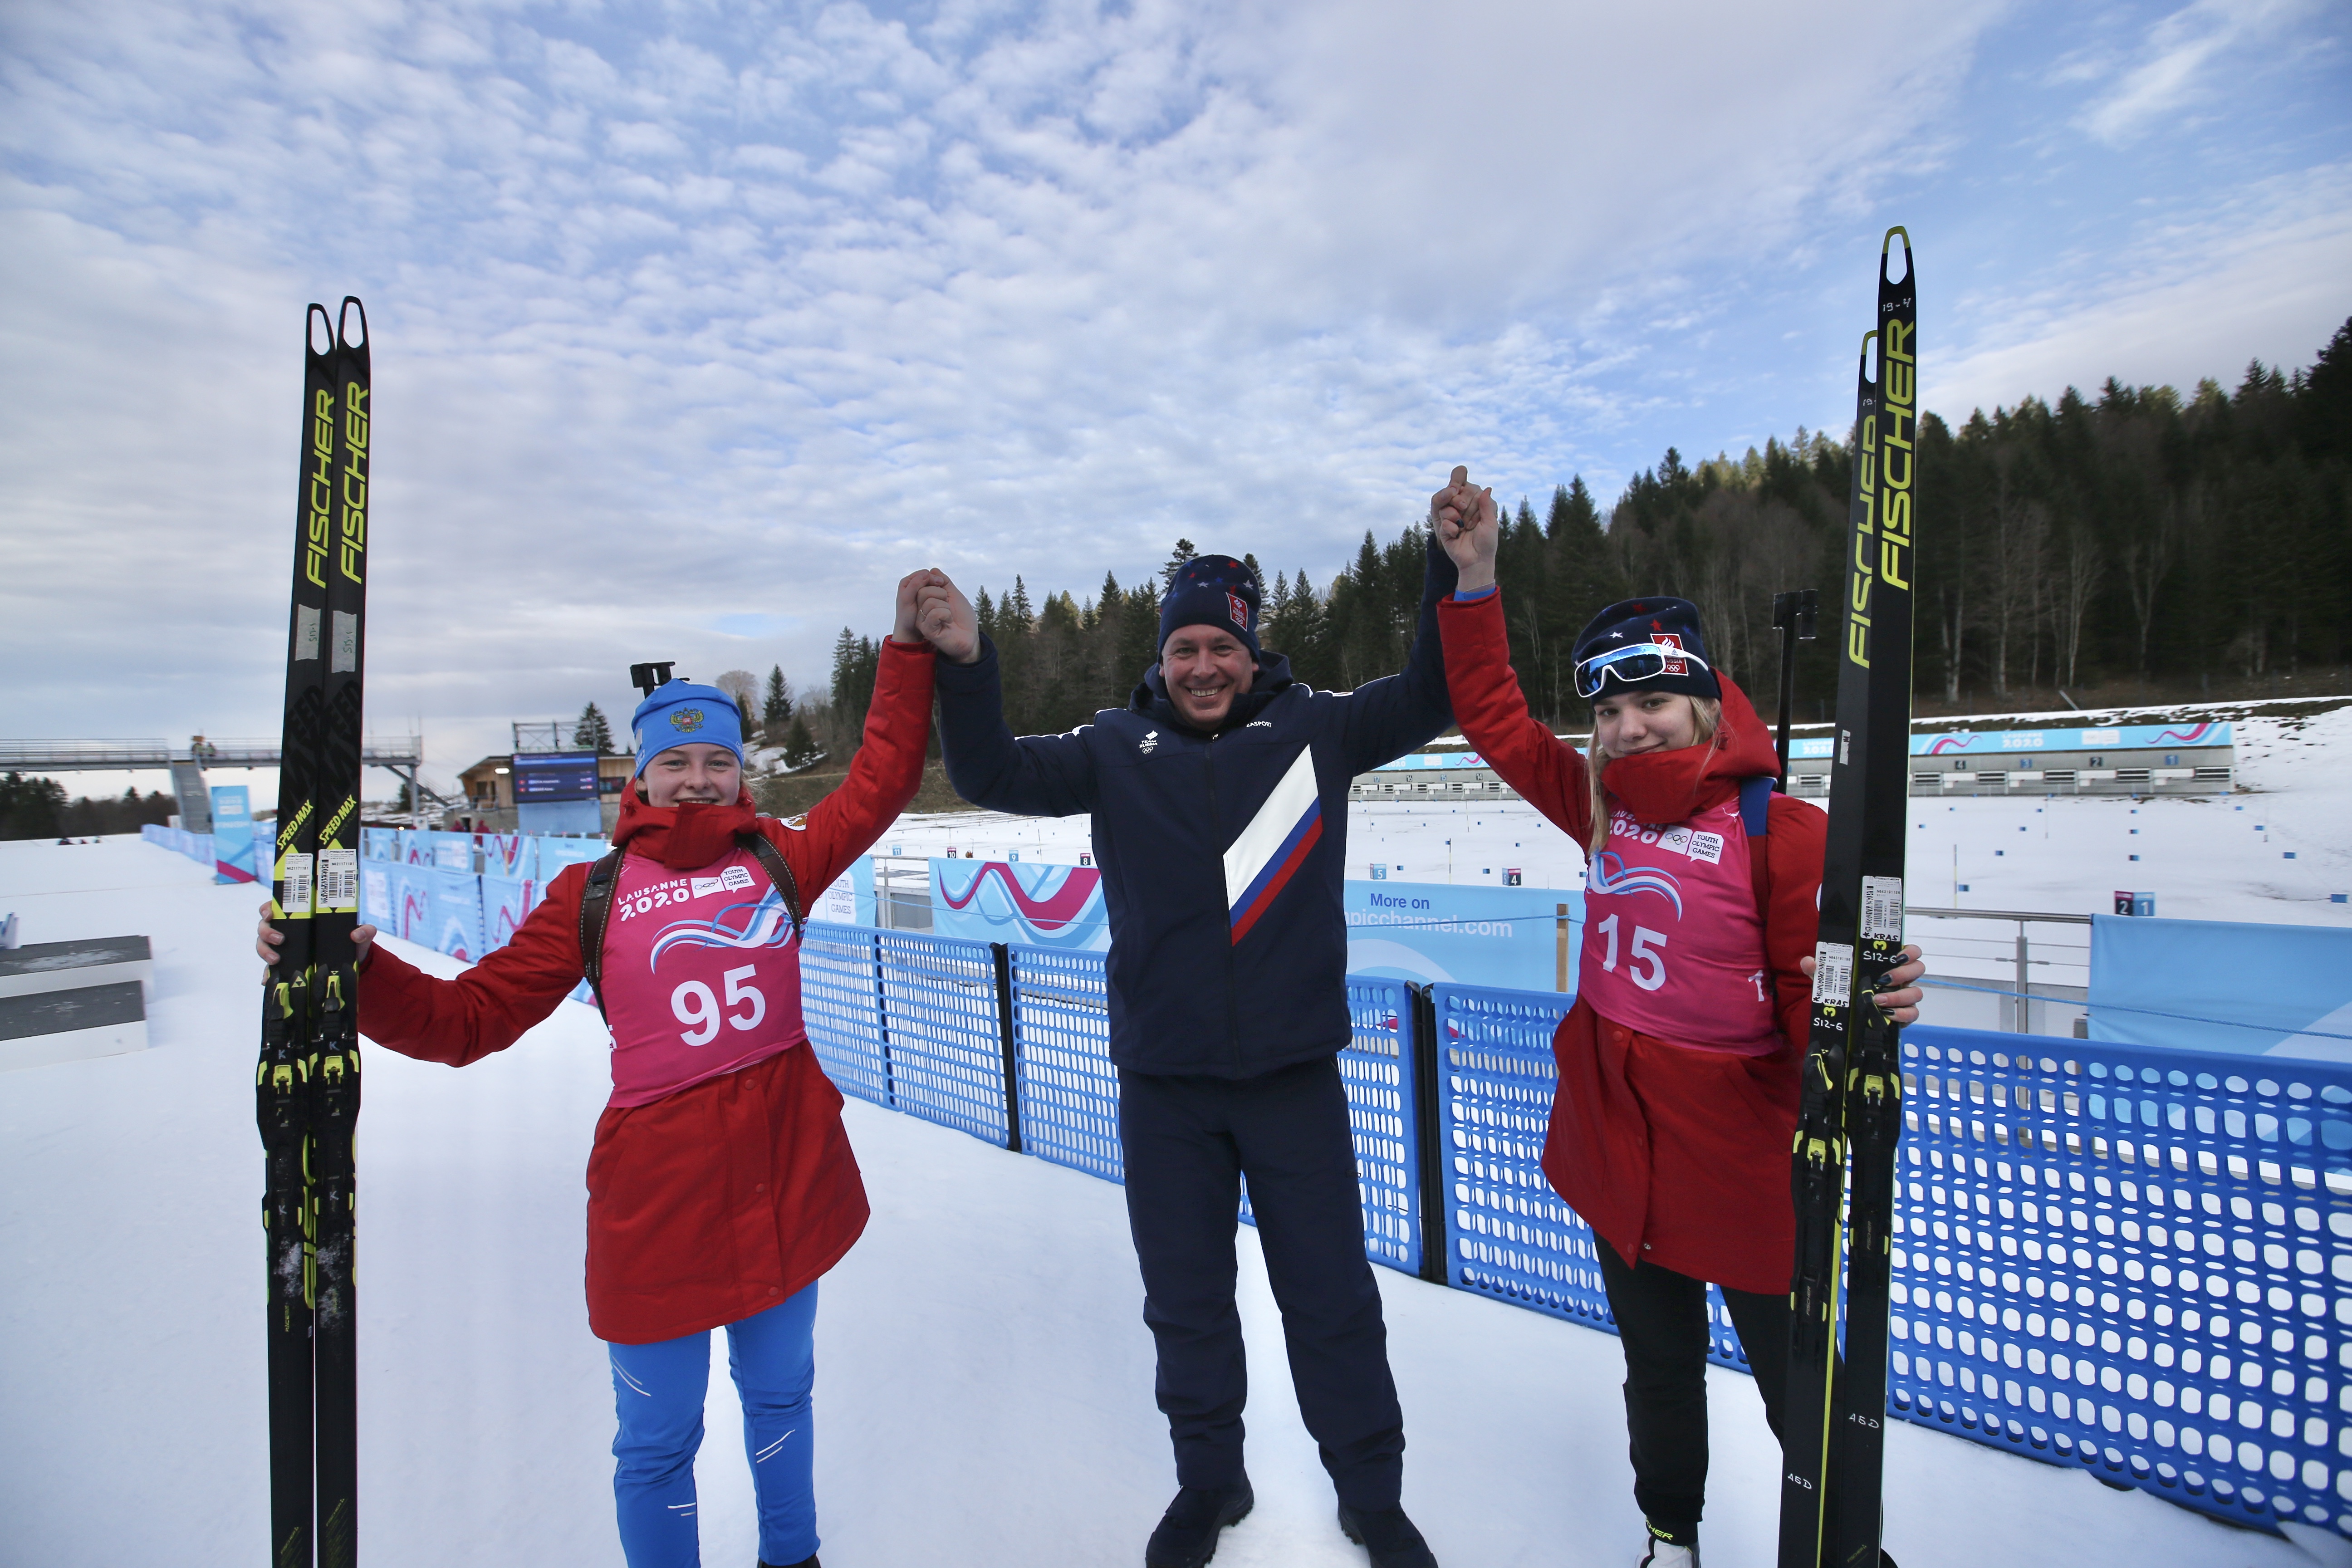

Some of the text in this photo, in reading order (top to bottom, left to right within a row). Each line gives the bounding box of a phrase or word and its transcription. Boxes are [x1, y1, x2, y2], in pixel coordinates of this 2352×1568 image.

[1881, 319, 1914, 591] FISCHER
[306, 389, 335, 588] FISCHER
[341, 382, 368, 584] FISCHER
[2003, 738, 2043, 748] 2020
[277, 820, 298, 850] SPEED
[295, 799, 314, 825] MAX
[319, 794, 357, 845] SPEED MAX
[1697, 834, 1719, 844] YOUTH
[1692, 840, 1720, 852] OLYMPIC
[1693, 848, 1715, 858] GAMES
[1377, 870, 1383, 879] 5
[1511, 874, 1518, 885] 4
[618, 879, 687, 905] LAUSANNE
[828, 891, 853, 902] OLYMPIC
[620, 888, 690, 921] 2020
[1370, 893, 1429, 909] More on
[831, 904, 851, 914] GAMES
[2120, 901, 2128, 914] 2
[2141, 901, 2149, 915] 1
[1598, 913, 1668, 991] 15
[671, 964, 766, 1046] 95
[1824, 998, 1848, 1007] KRAS
[1813, 1018, 1842, 1031] S12-6
[329, 1041, 340, 1051] K
[278, 1049, 286, 1059] K
[329, 1190, 339, 1200] K
[278, 1205, 287, 1215] K
